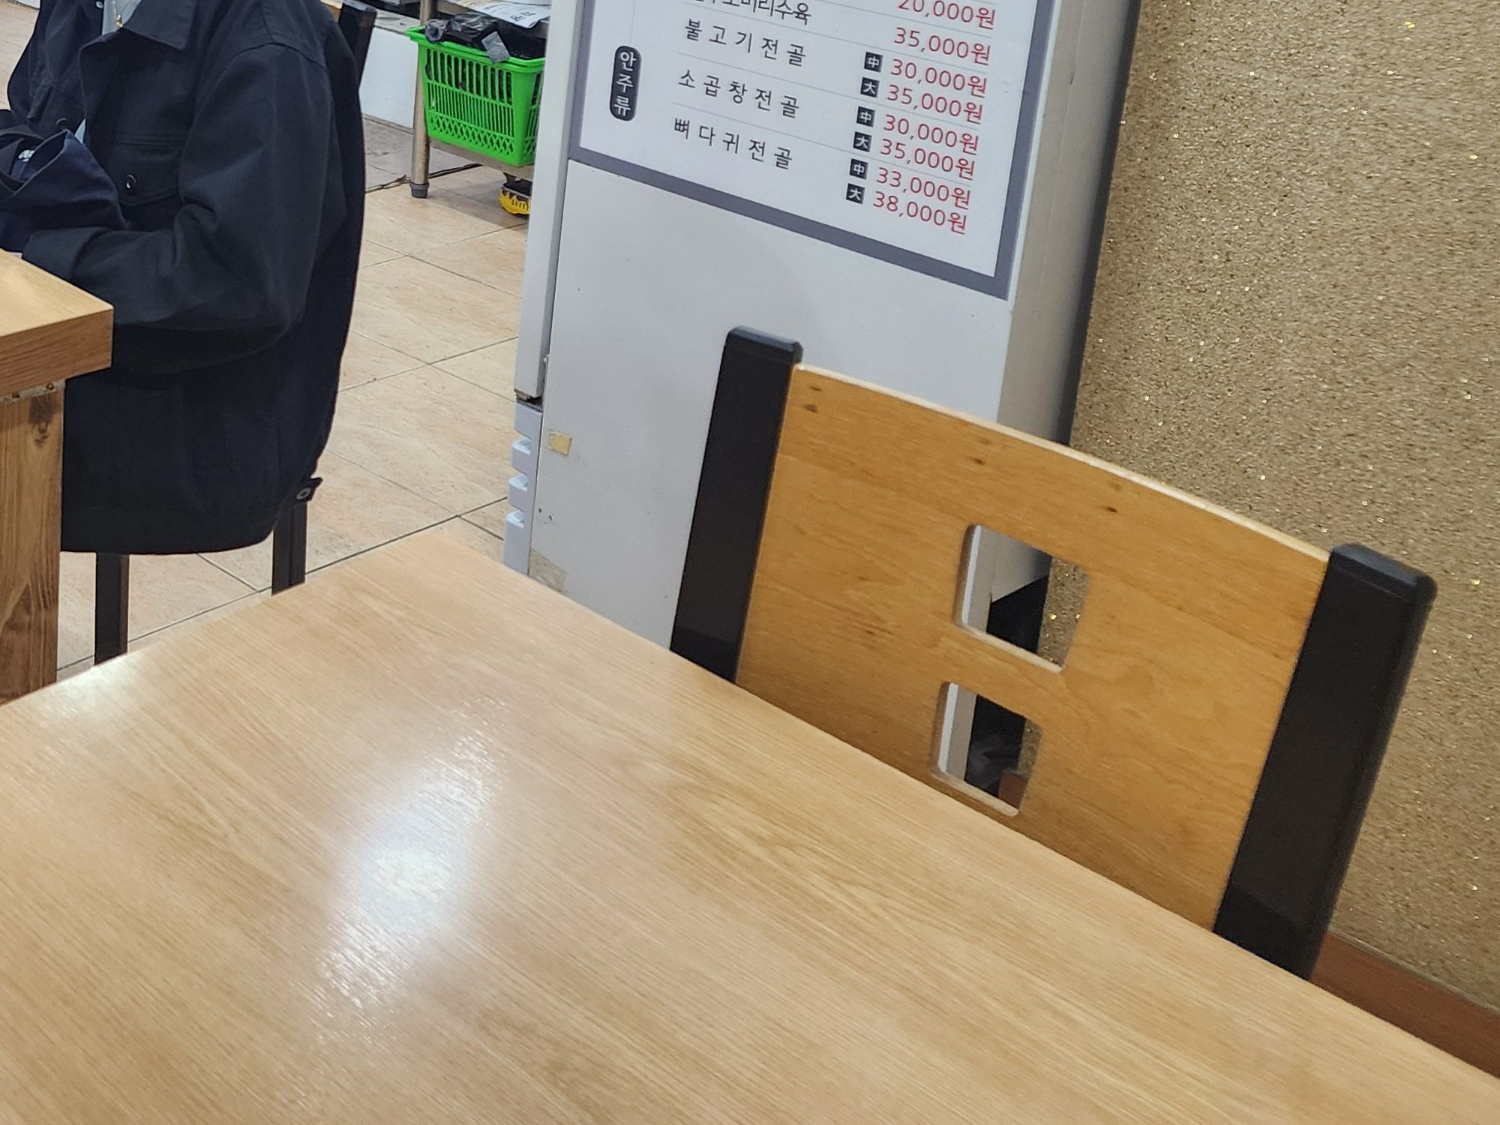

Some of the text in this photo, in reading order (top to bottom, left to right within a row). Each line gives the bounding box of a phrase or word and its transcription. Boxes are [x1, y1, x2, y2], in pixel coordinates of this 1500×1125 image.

[685, 18, 807, 68] 불고기전골
[894, 27, 991, 67] 35,000원
[614, 53, 637, 116] 안주류
[678, 69, 800, 120] 소곱창전골
[889, 59, 988, 99] 30,000원
[886, 84, 984, 126] 35,000원
[673, 117, 794, 171] 뼈다귀전골
[882, 114, 980, 156] 30,000원
[879, 138, 976, 181] 35,000원
[875, 166, 971, 210] 33,000원
[872, 190, 967, 236] 38,000원
